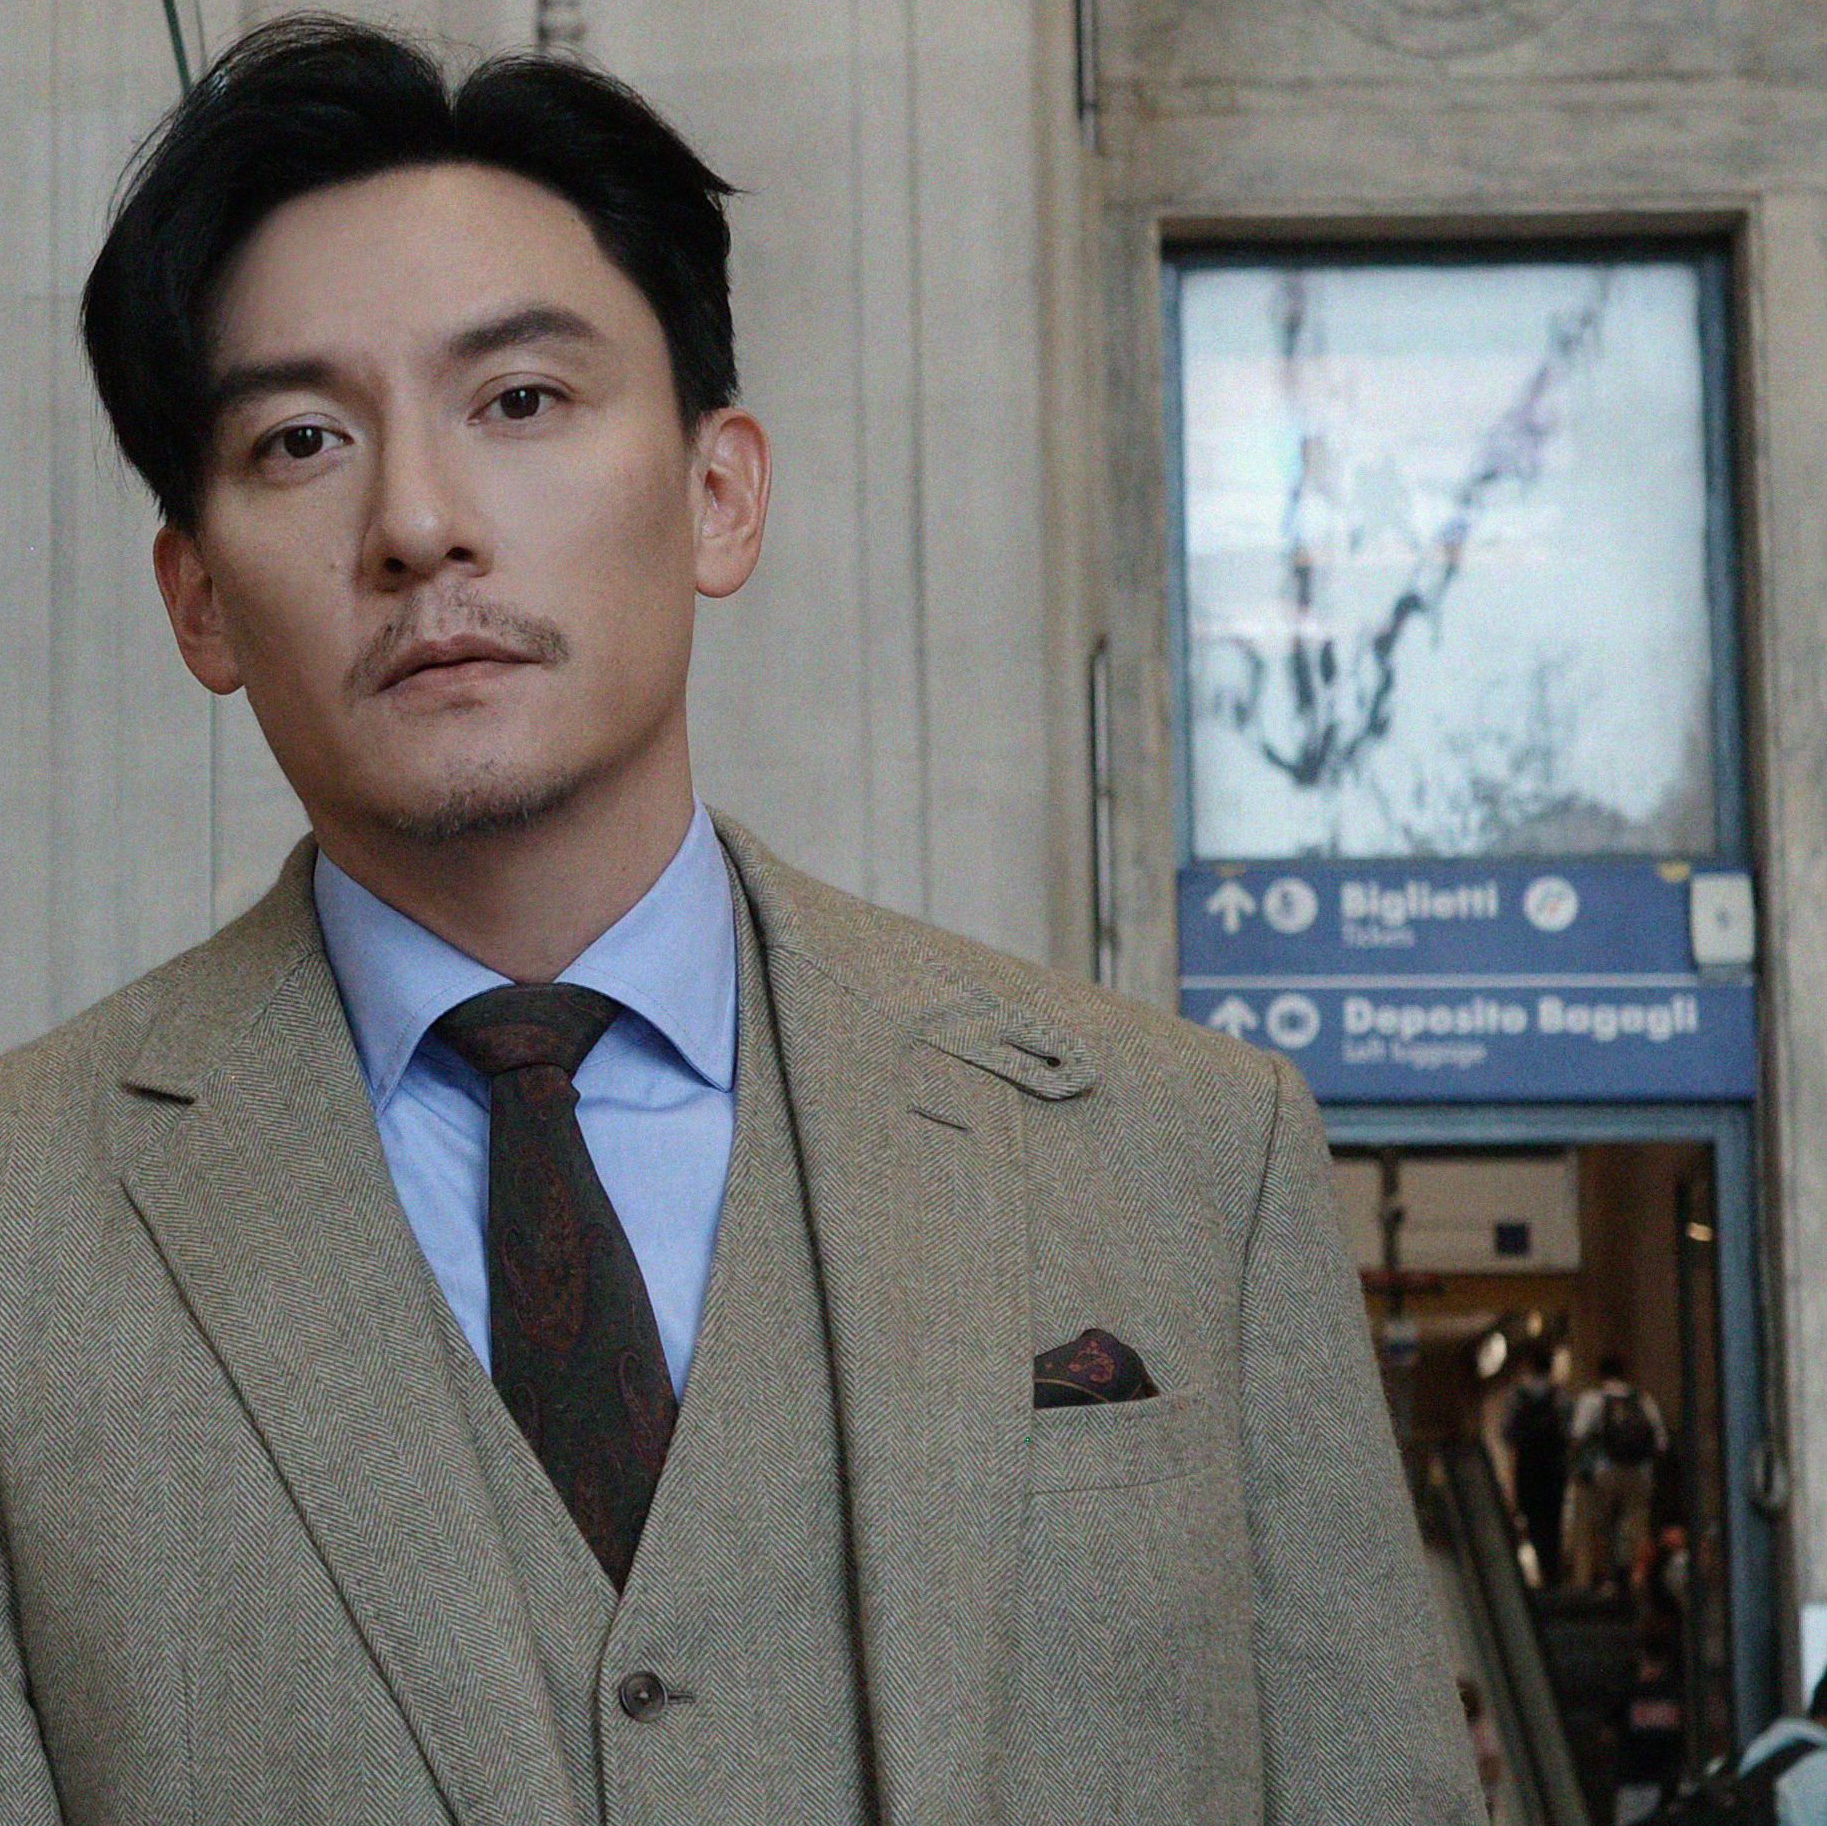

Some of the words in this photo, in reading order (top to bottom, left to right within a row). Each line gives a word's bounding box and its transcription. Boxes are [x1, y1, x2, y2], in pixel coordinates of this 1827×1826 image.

[1340, 881, 1500, 927] Biglietti
[1341, 995, 1526, 1038] Deposito
[1538, 995, 1699, 1042] Bagagli
